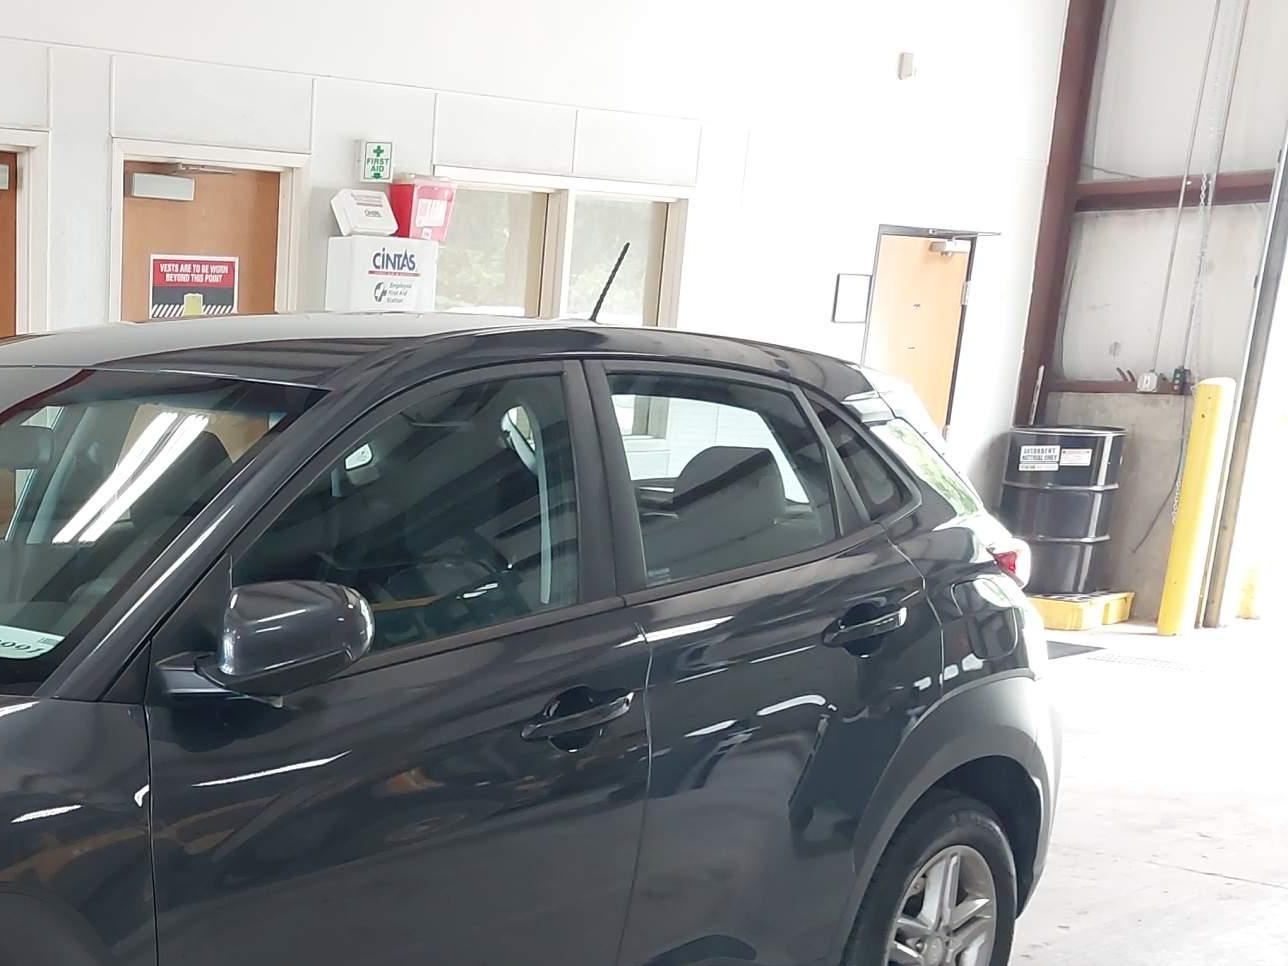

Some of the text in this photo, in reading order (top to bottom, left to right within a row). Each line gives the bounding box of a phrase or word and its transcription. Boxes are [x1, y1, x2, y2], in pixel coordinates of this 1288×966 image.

[159, 263, 229, 274] VESTS ARE TO BE WORN
[165, 273, 223, 283] BEYOND THIS POINT
